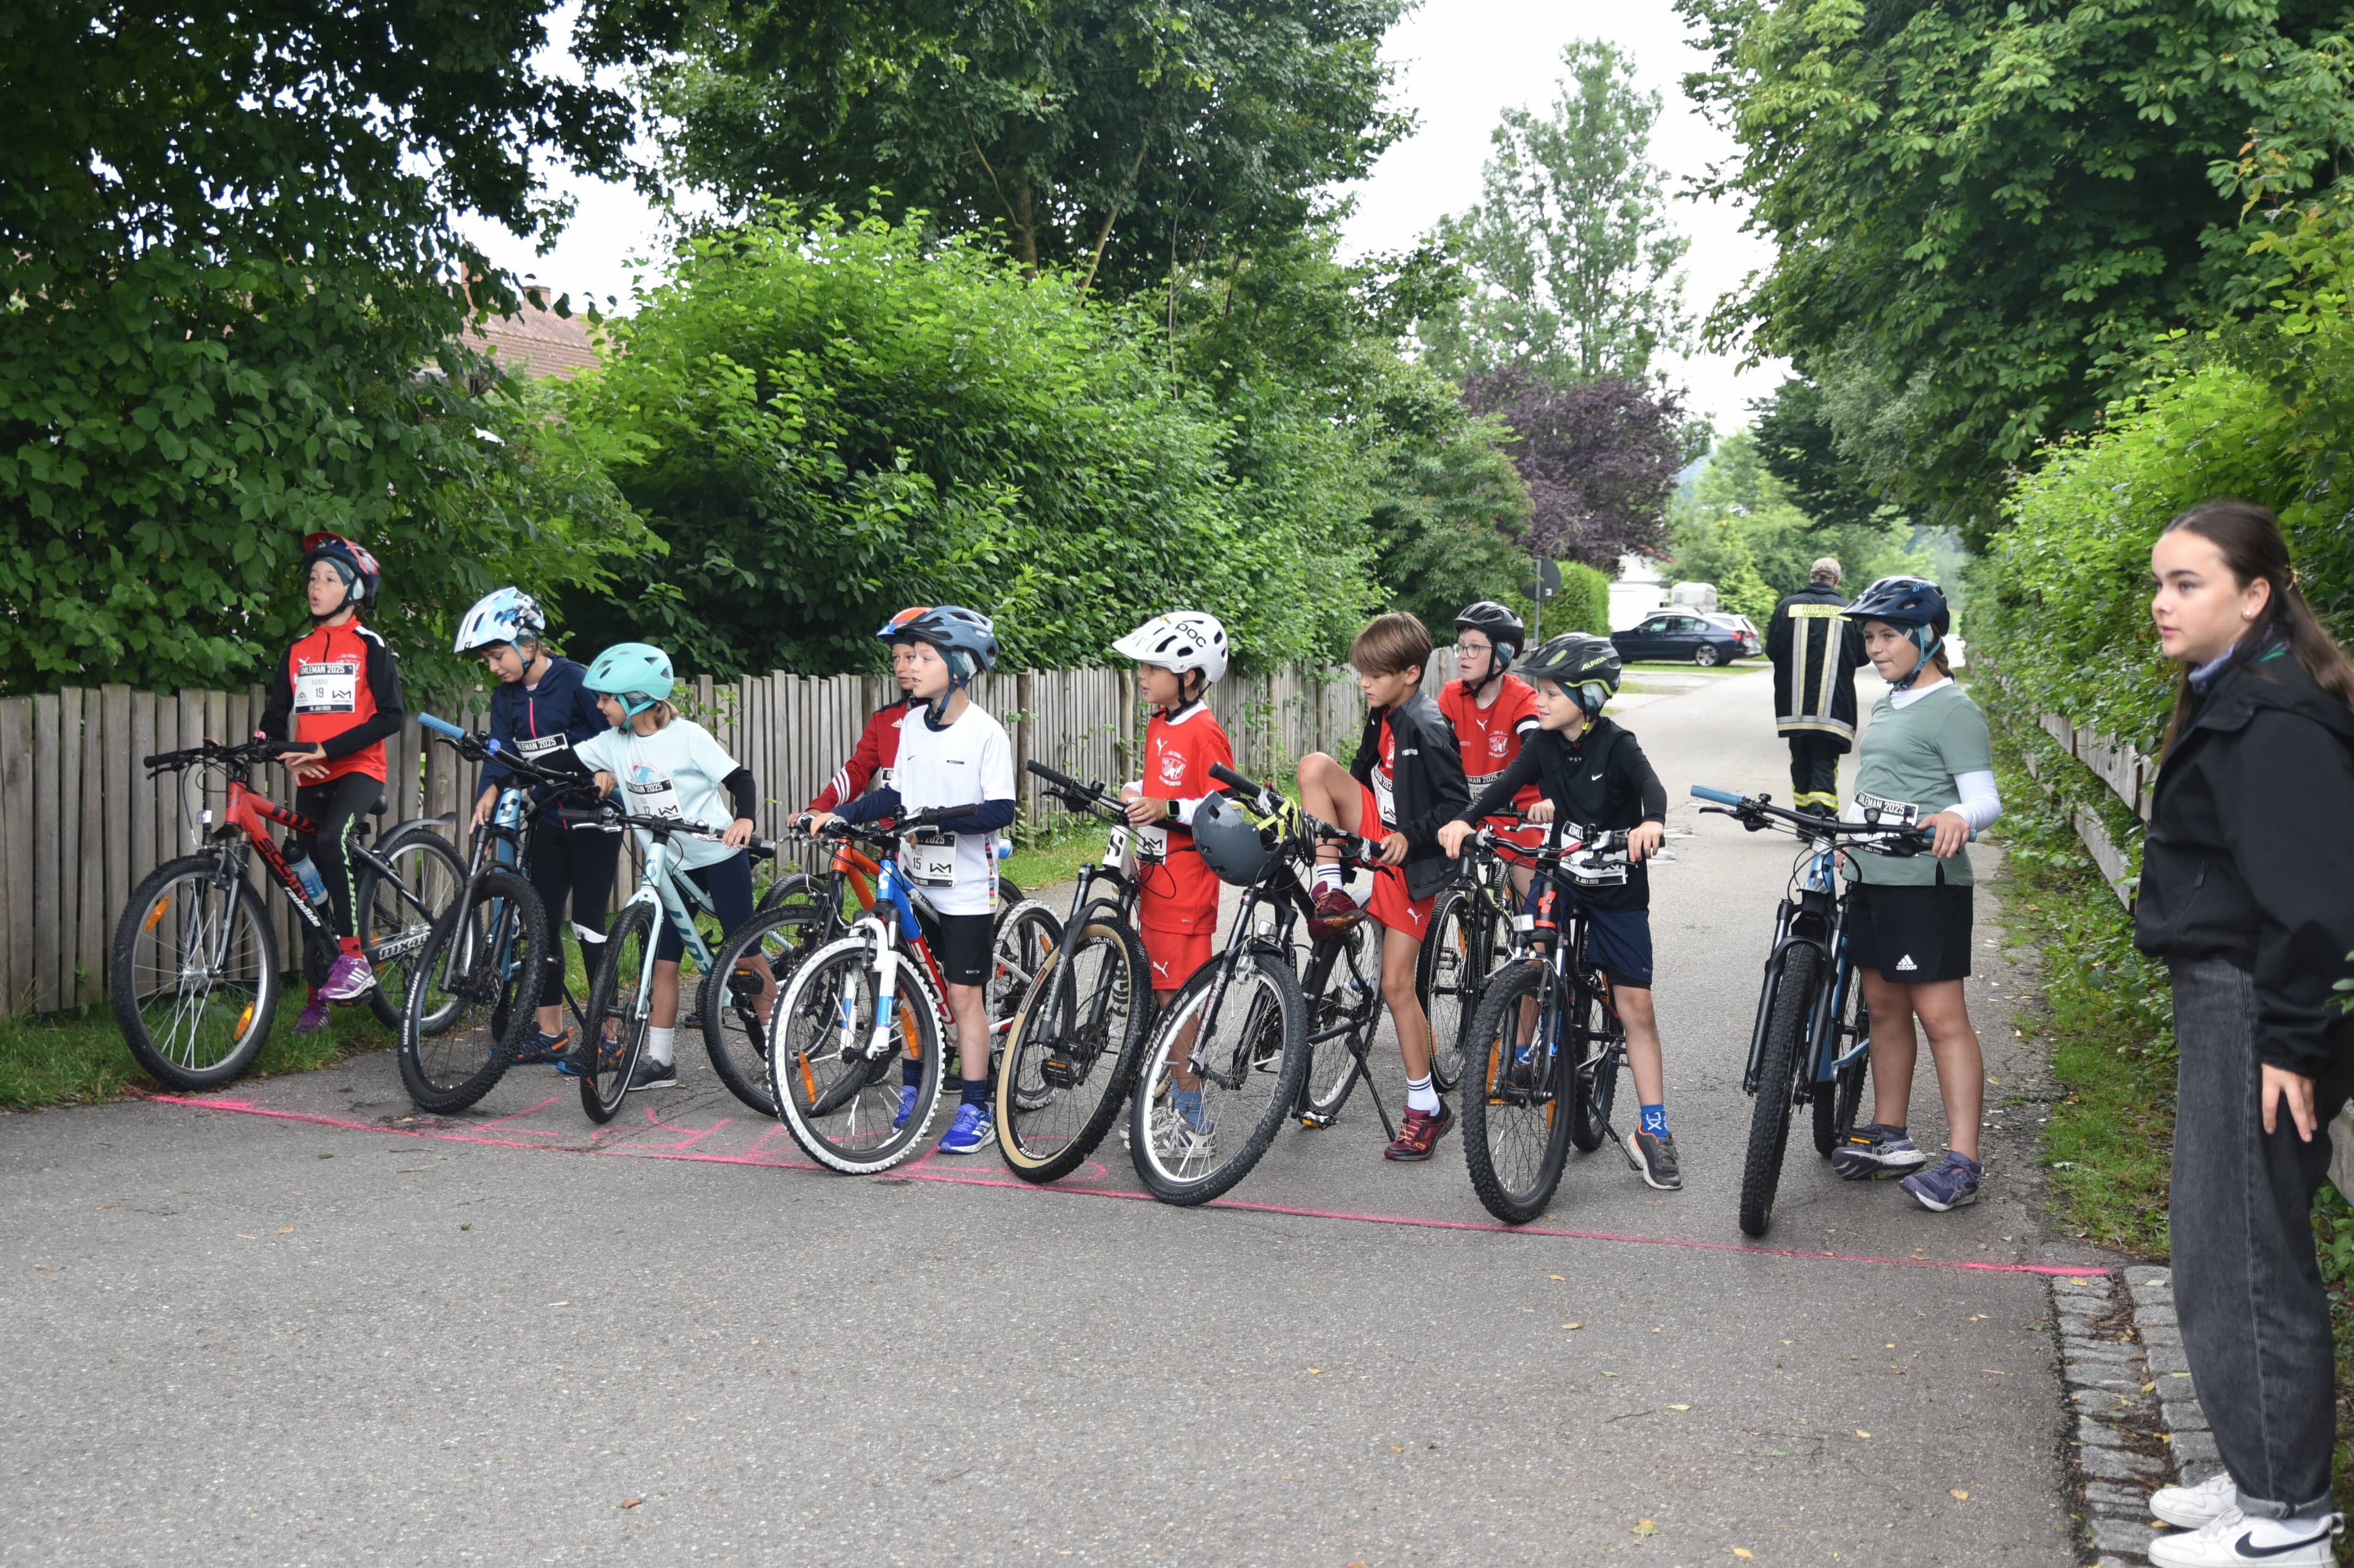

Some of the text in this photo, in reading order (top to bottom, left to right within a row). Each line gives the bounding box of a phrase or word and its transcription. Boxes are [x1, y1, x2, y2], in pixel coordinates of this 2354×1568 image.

[327, 664, 345, 674] 2025
[316, 687, 324, 698] 19
[539, 737, 556, 750] 2025
[646, 782, 663, 793] 2025
[1382, 779, 1392, 791] 202
[1883, 802, 1905, 814] 2025
[913, 857, 921, 870] 15
[403, 971, 421, 1044] SMART SAM
[1140, 991, 1190, 1079] SCHWALBE
